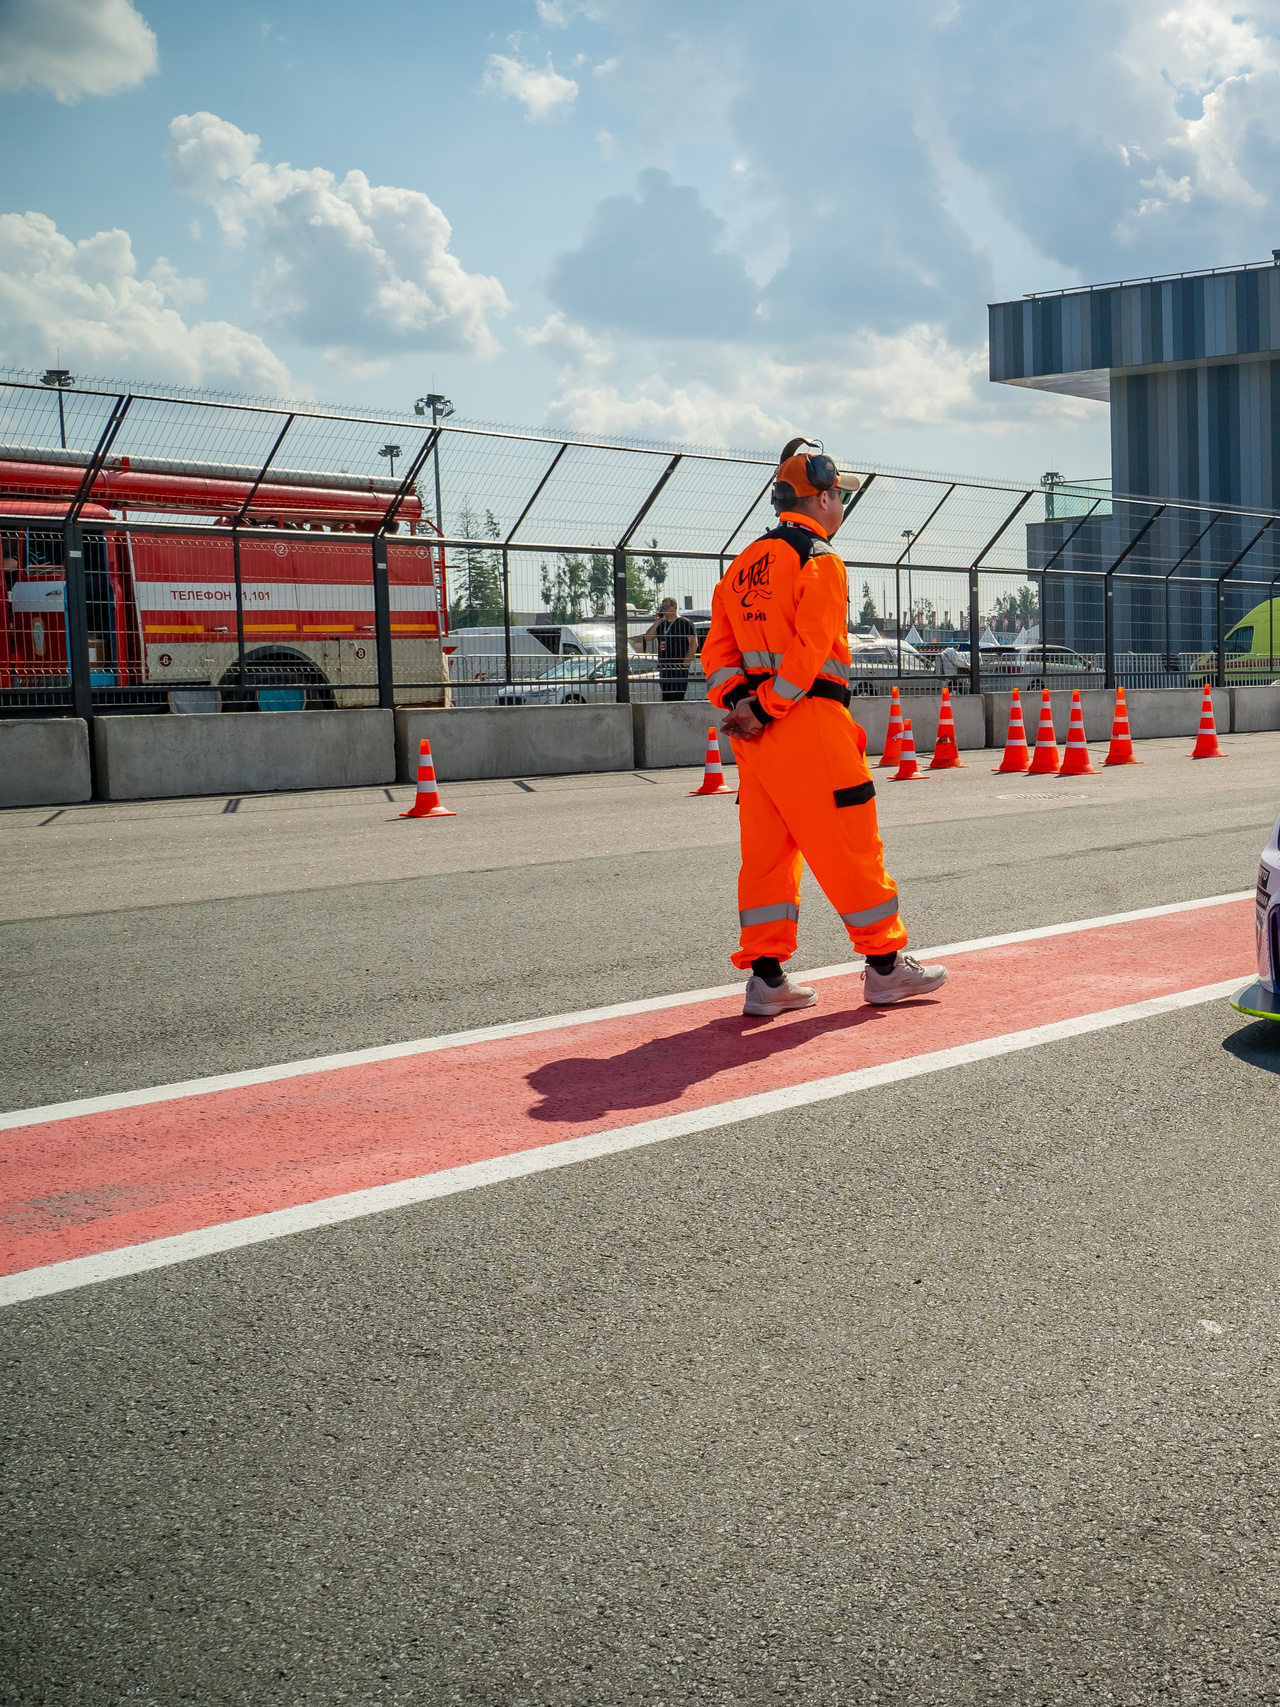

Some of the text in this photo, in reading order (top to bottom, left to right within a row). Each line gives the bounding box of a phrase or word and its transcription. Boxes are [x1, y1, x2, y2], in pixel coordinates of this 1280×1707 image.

[277, 545, 285, 554] 2
[418, 548, 427, 556] 4
[170, 590, 232, 601] ТЕЛЕФОН
[357, 649, 364, 658] 8
[162, 656, 169, 665] 6
